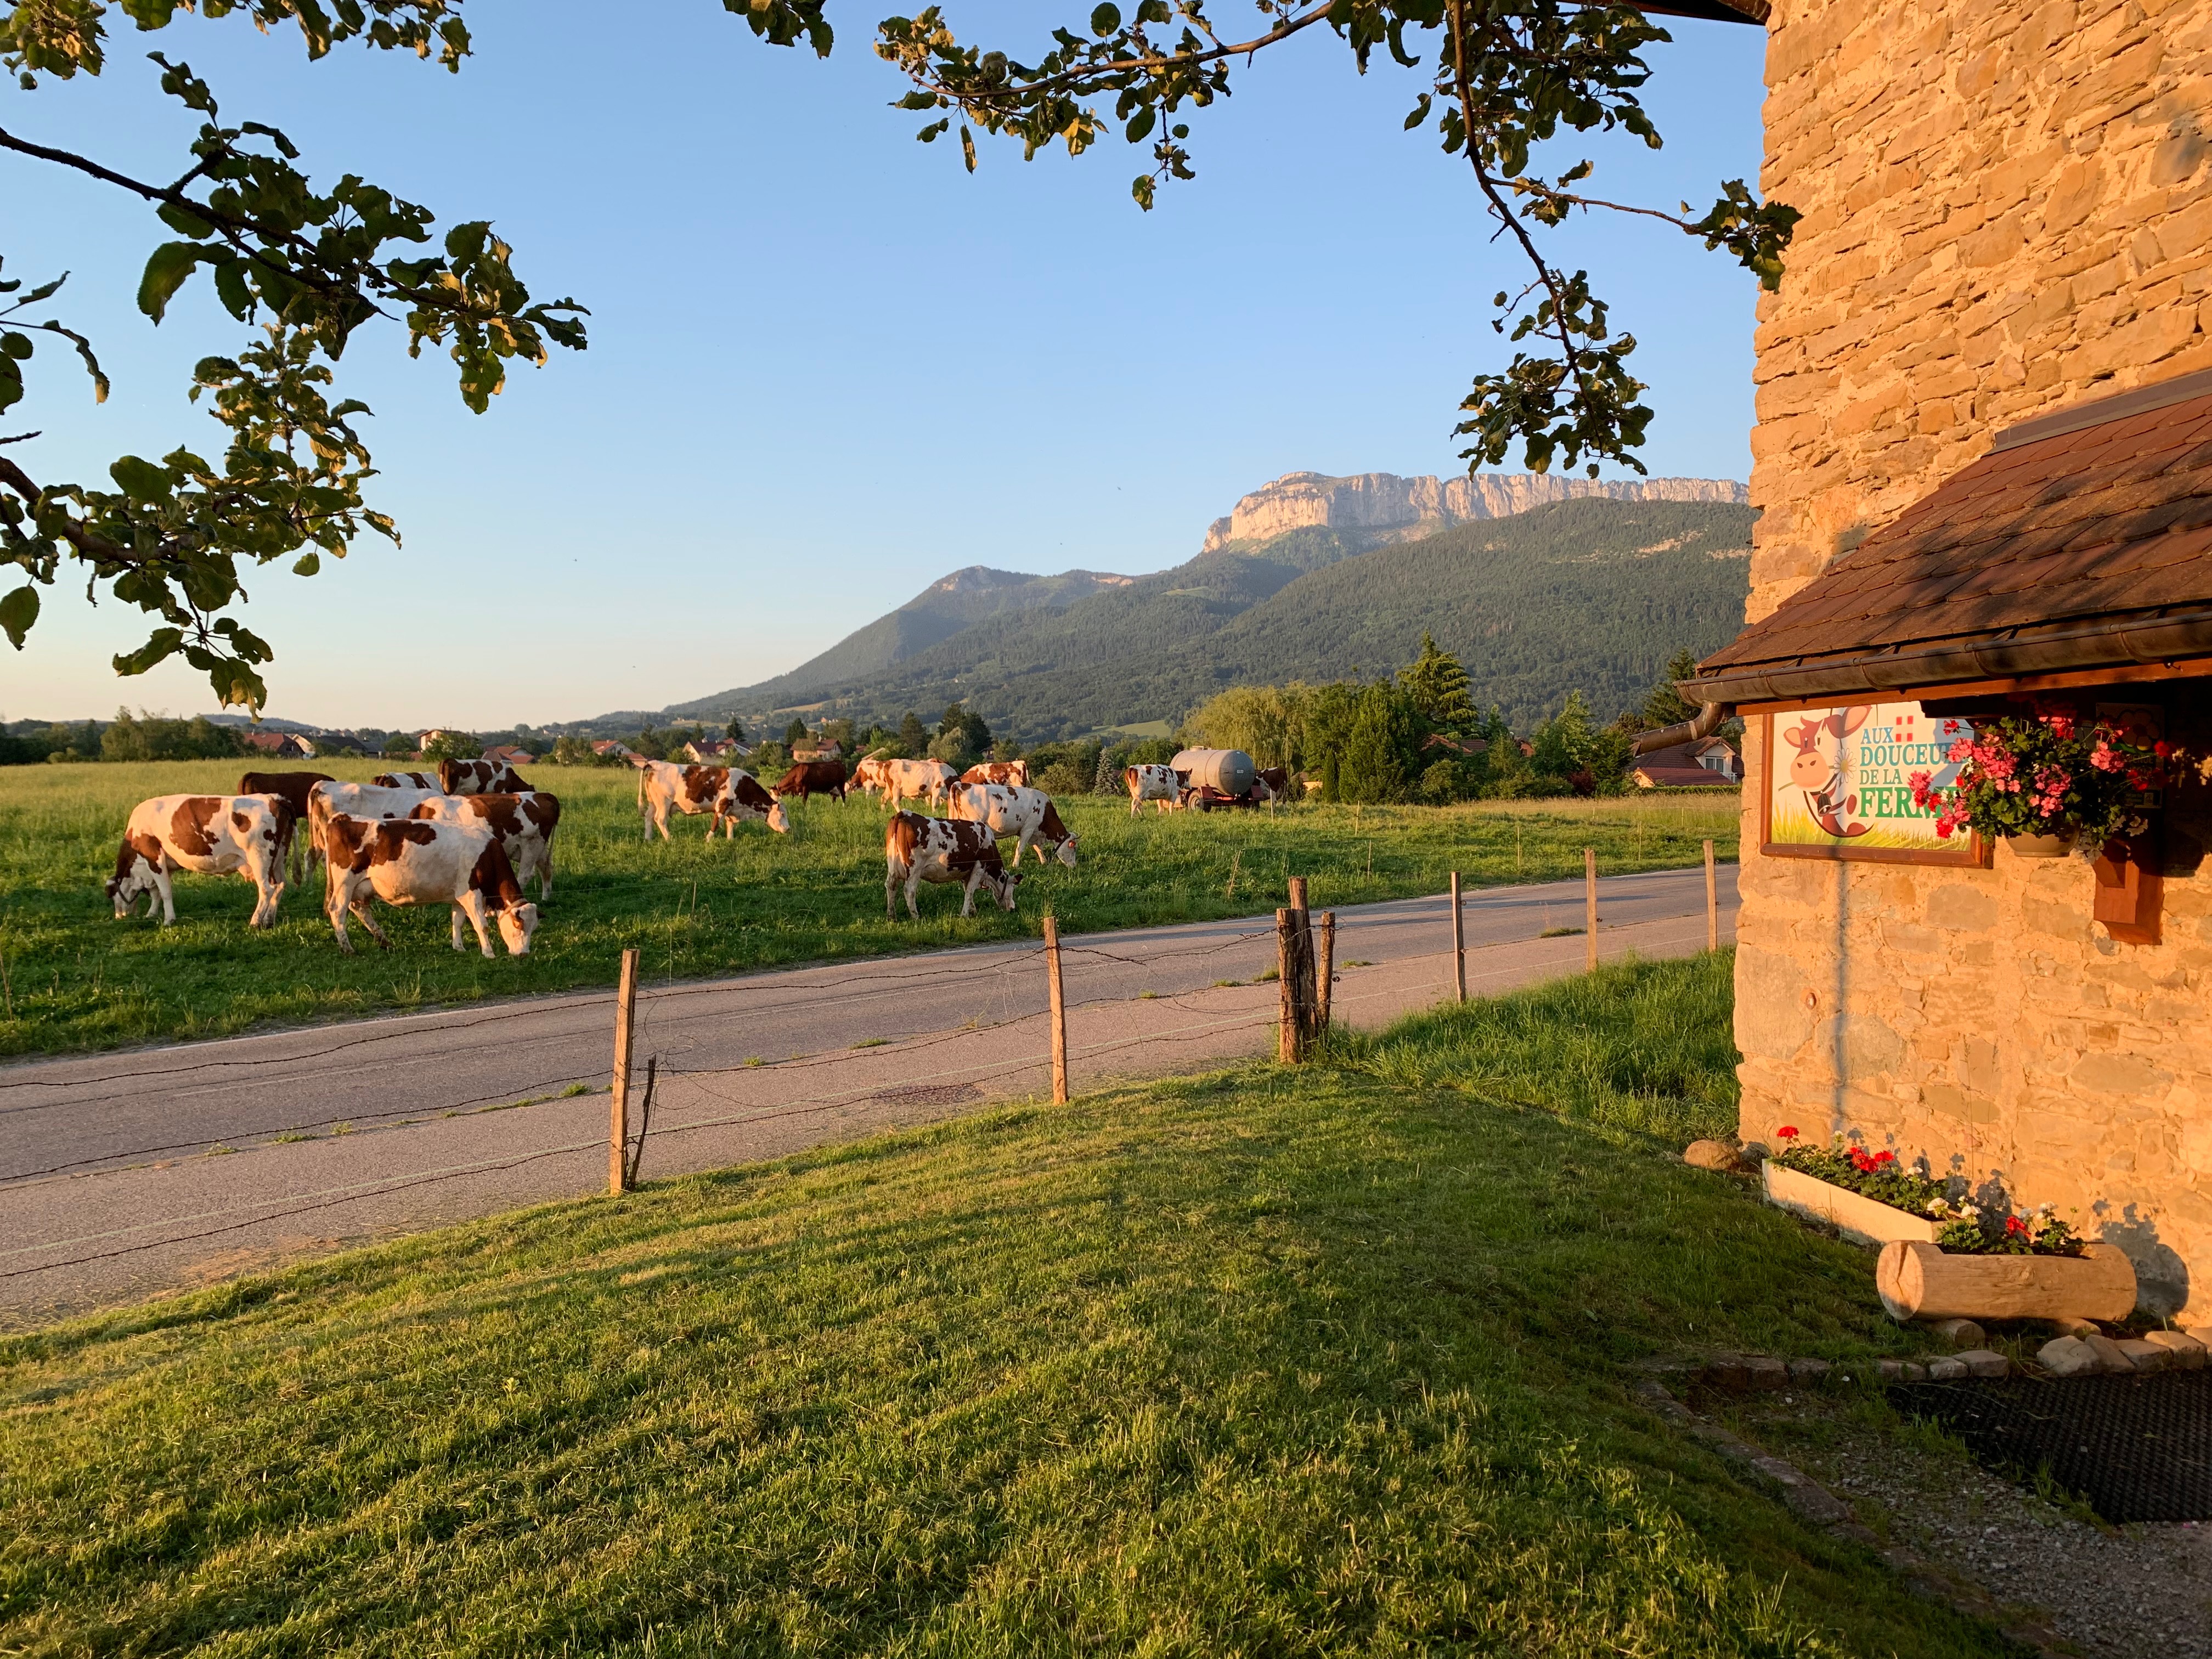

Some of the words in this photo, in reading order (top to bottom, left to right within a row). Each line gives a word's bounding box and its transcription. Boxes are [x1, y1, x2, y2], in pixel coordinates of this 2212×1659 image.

[1860, 727, 1894, 744] AUX
[1860, 742, 1968, 766] DOUCEU
[1859, 769, 1879, 785] DE
[1883, 769, 1903, 785] LA
